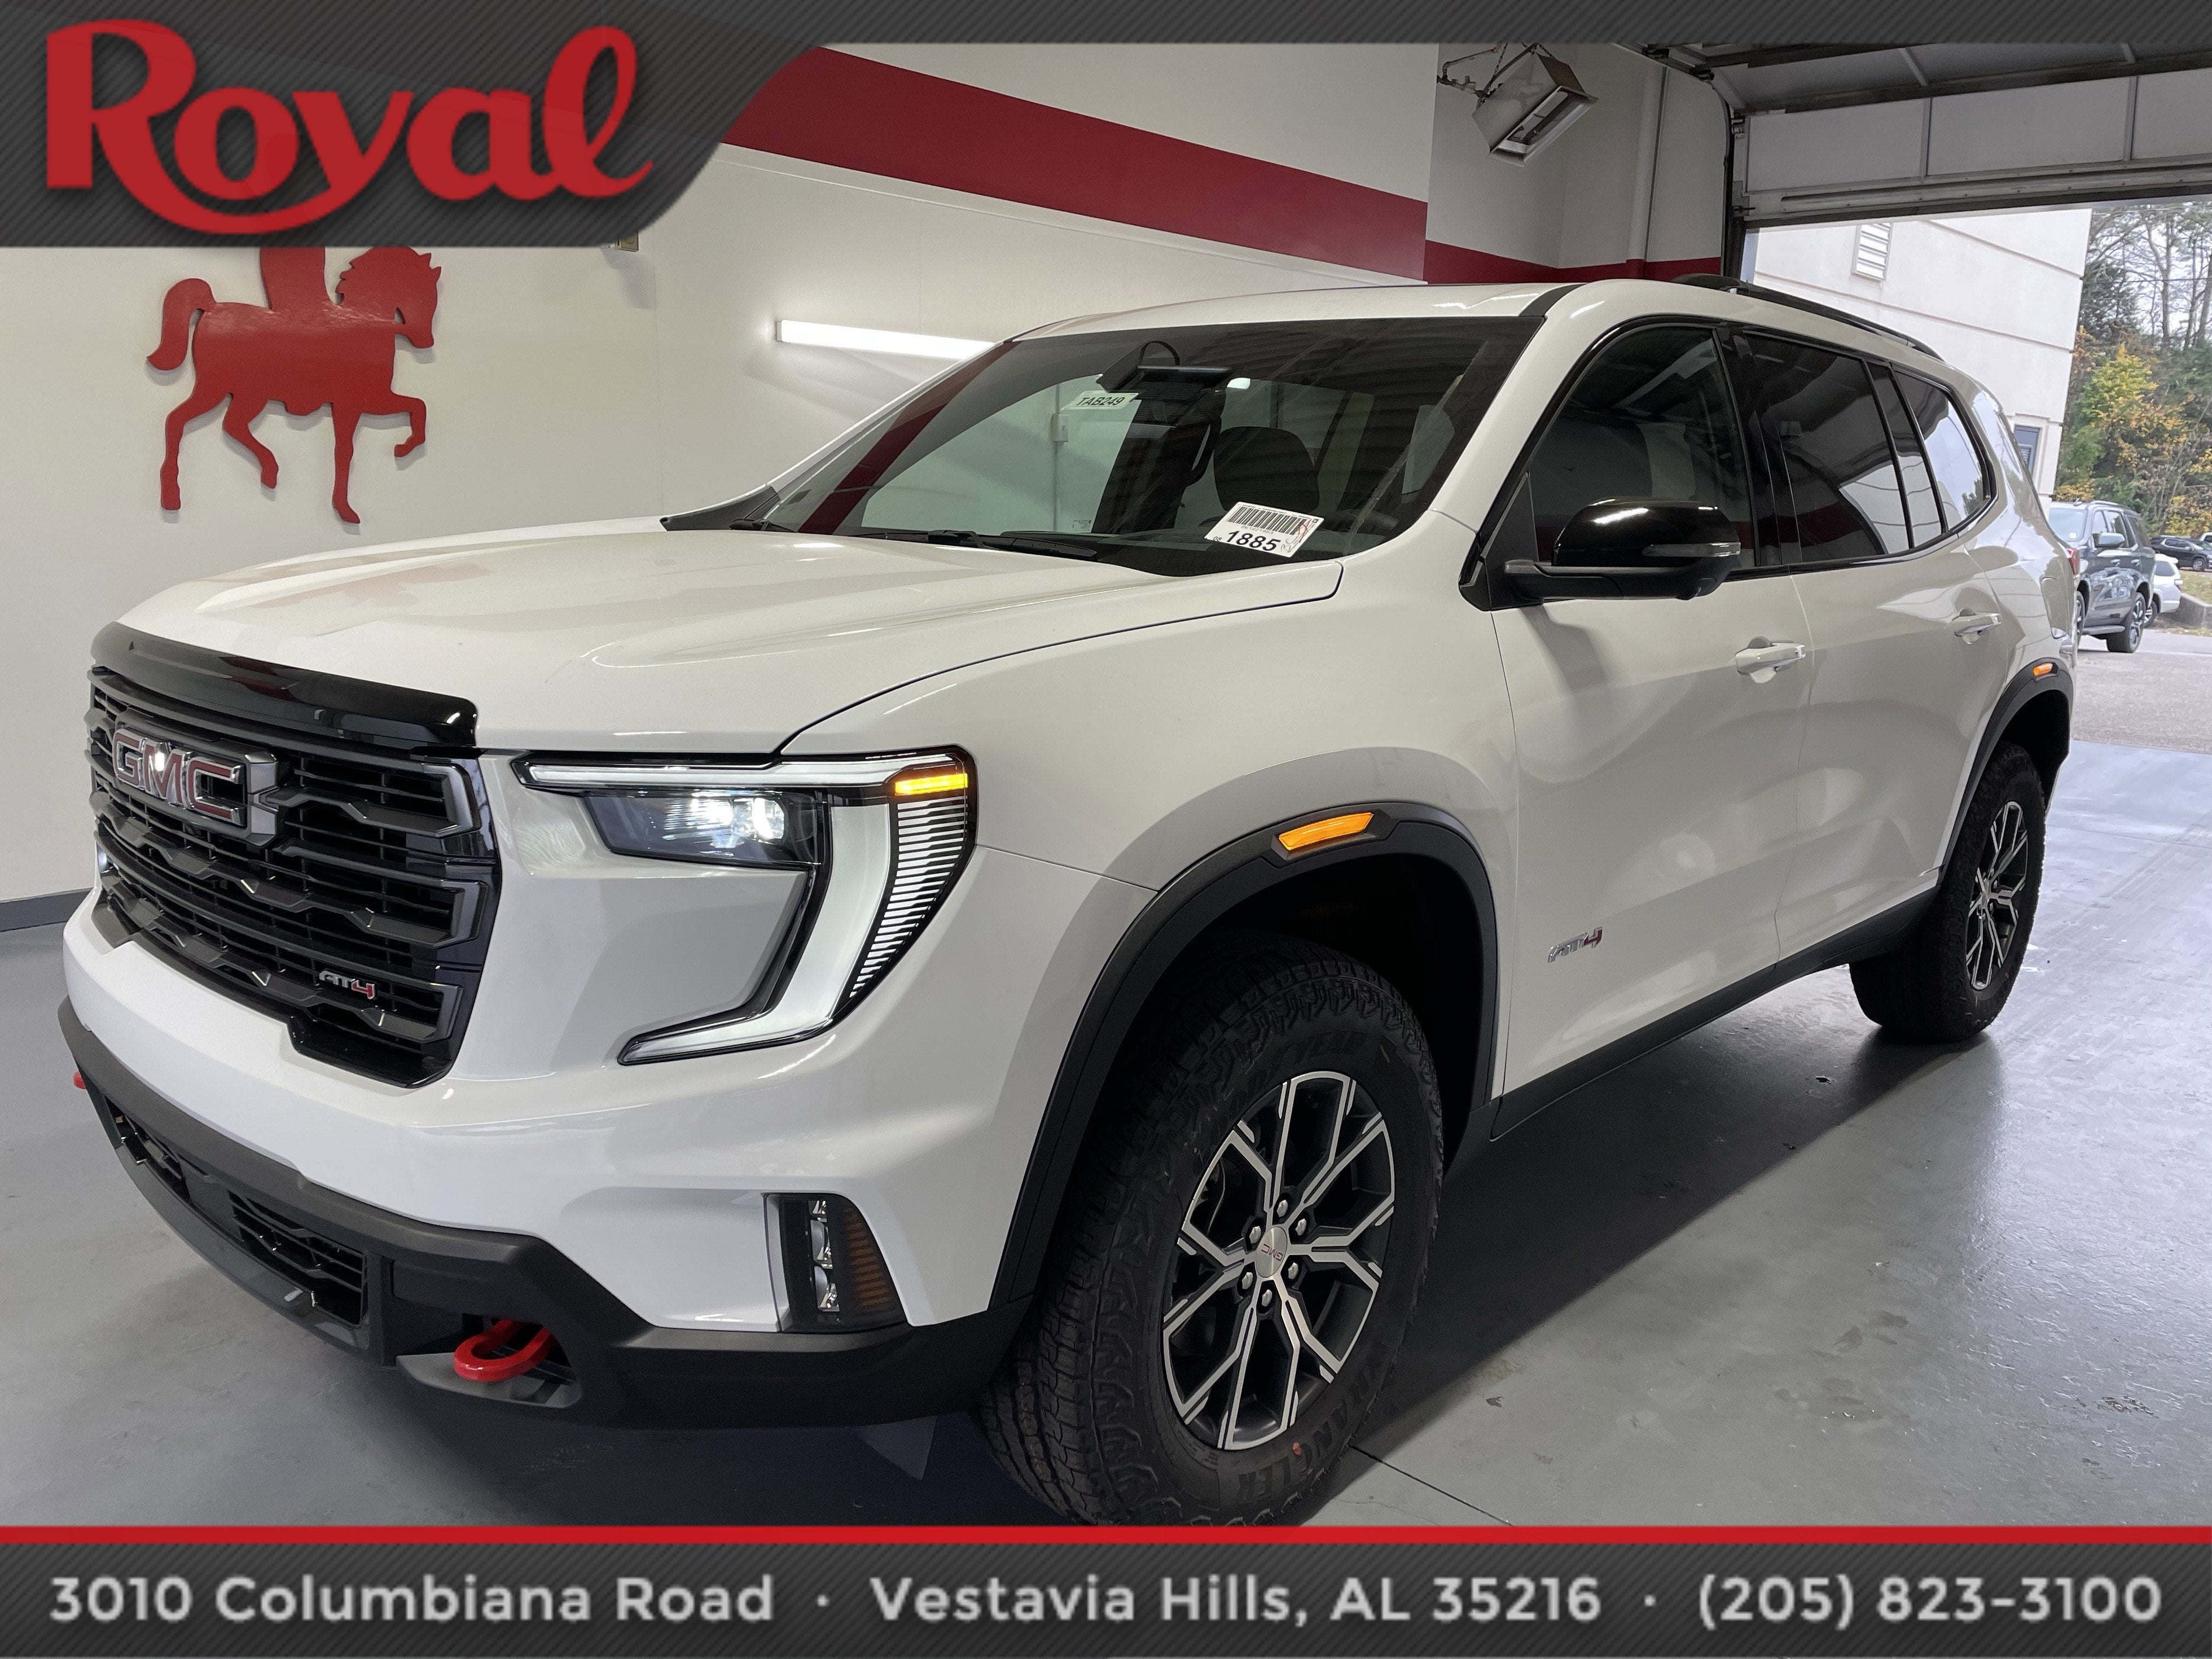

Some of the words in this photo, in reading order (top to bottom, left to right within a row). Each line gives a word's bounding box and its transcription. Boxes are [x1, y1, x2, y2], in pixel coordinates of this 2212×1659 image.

[1076, 397, 1125, 405] TAB249
[1226, 531, 1281, 551] 1885
[112, 727, 245, 827] GMC
[1547, 926, 1603, 963] AT4
[319, 970, 375, 1000] AT4
[1261, 1243, 1284, 1262] GMC
[1234, 1338, 1389, 1505] WRANGLER
